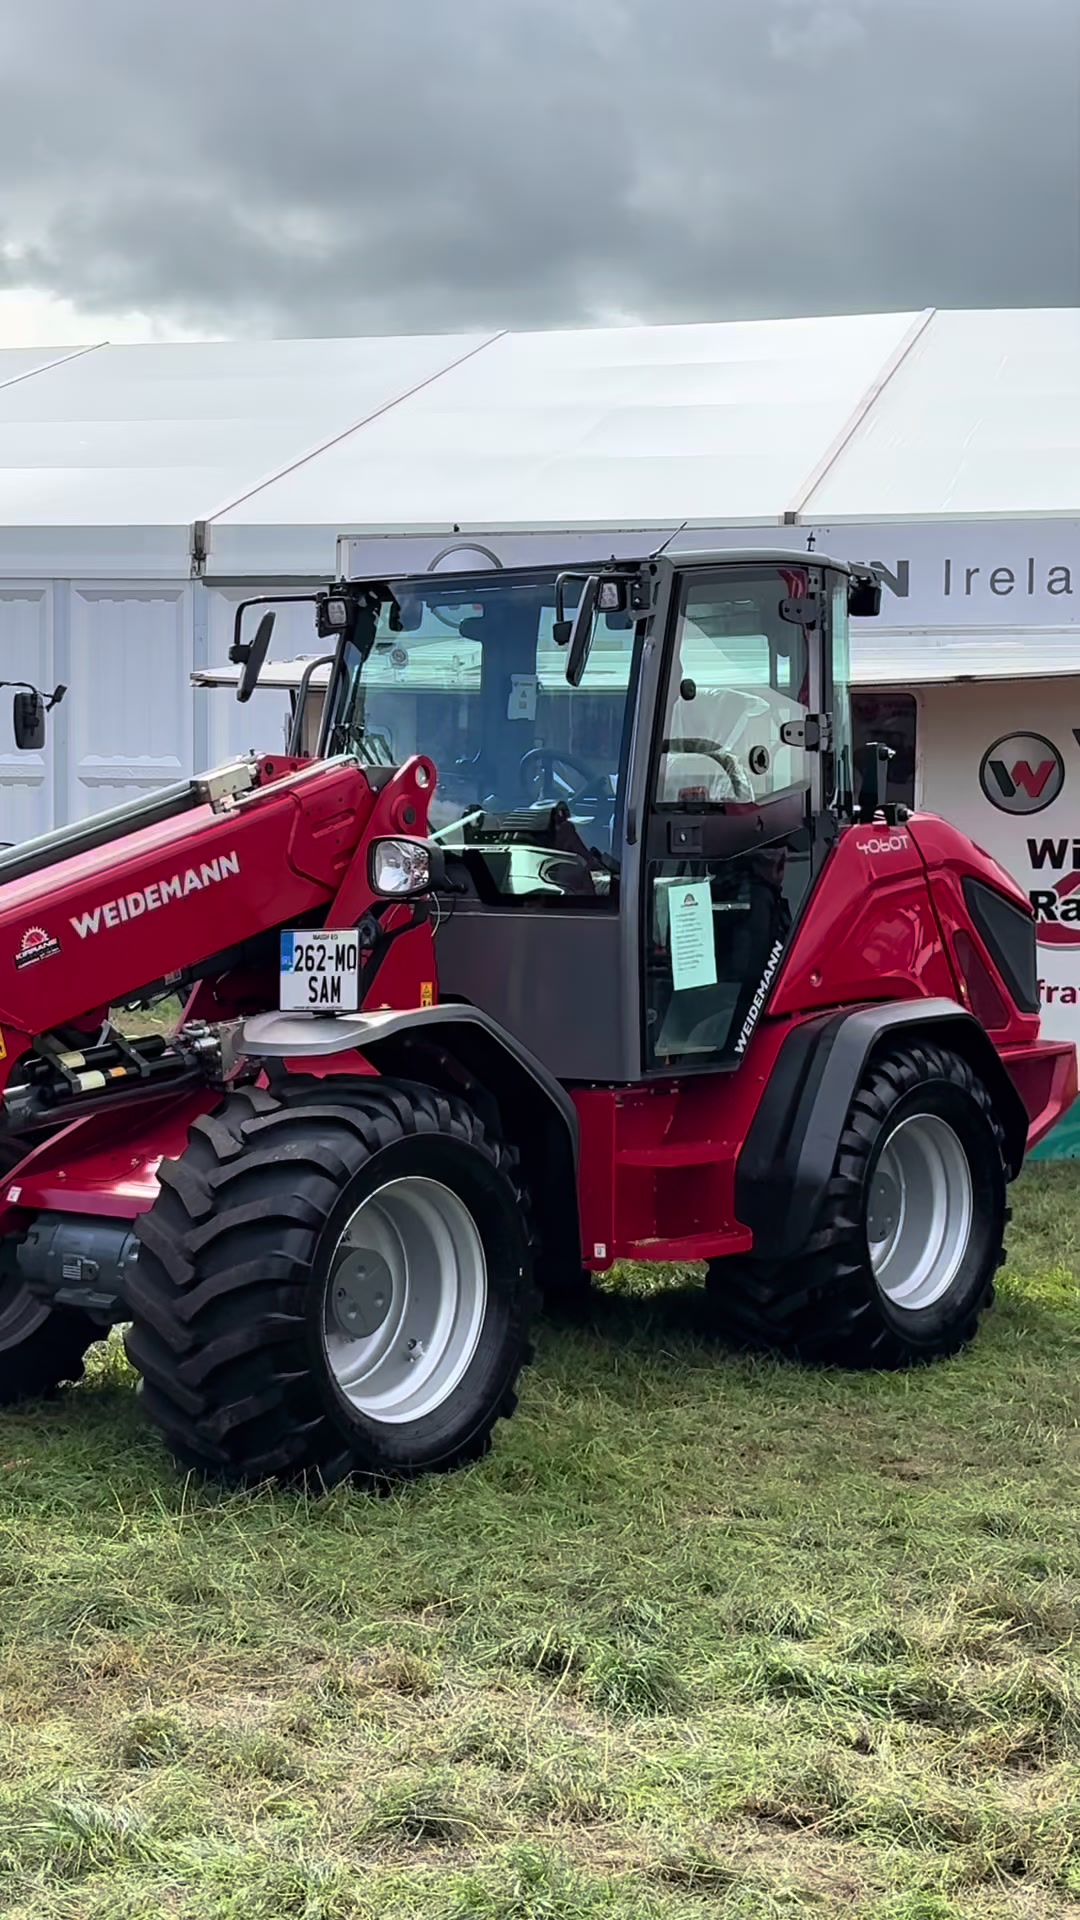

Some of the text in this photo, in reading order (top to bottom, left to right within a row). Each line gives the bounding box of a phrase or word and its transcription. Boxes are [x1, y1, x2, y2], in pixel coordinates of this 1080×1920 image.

[944, 557, 1074, 596] Irela
[68, 850, 241, 940] WEIDEMANN
[308, 975, 341, 1003] SAM
[734, 940, 784, 1053] WEIDEMANN
[1036, 979, 1080, 1004] fra
